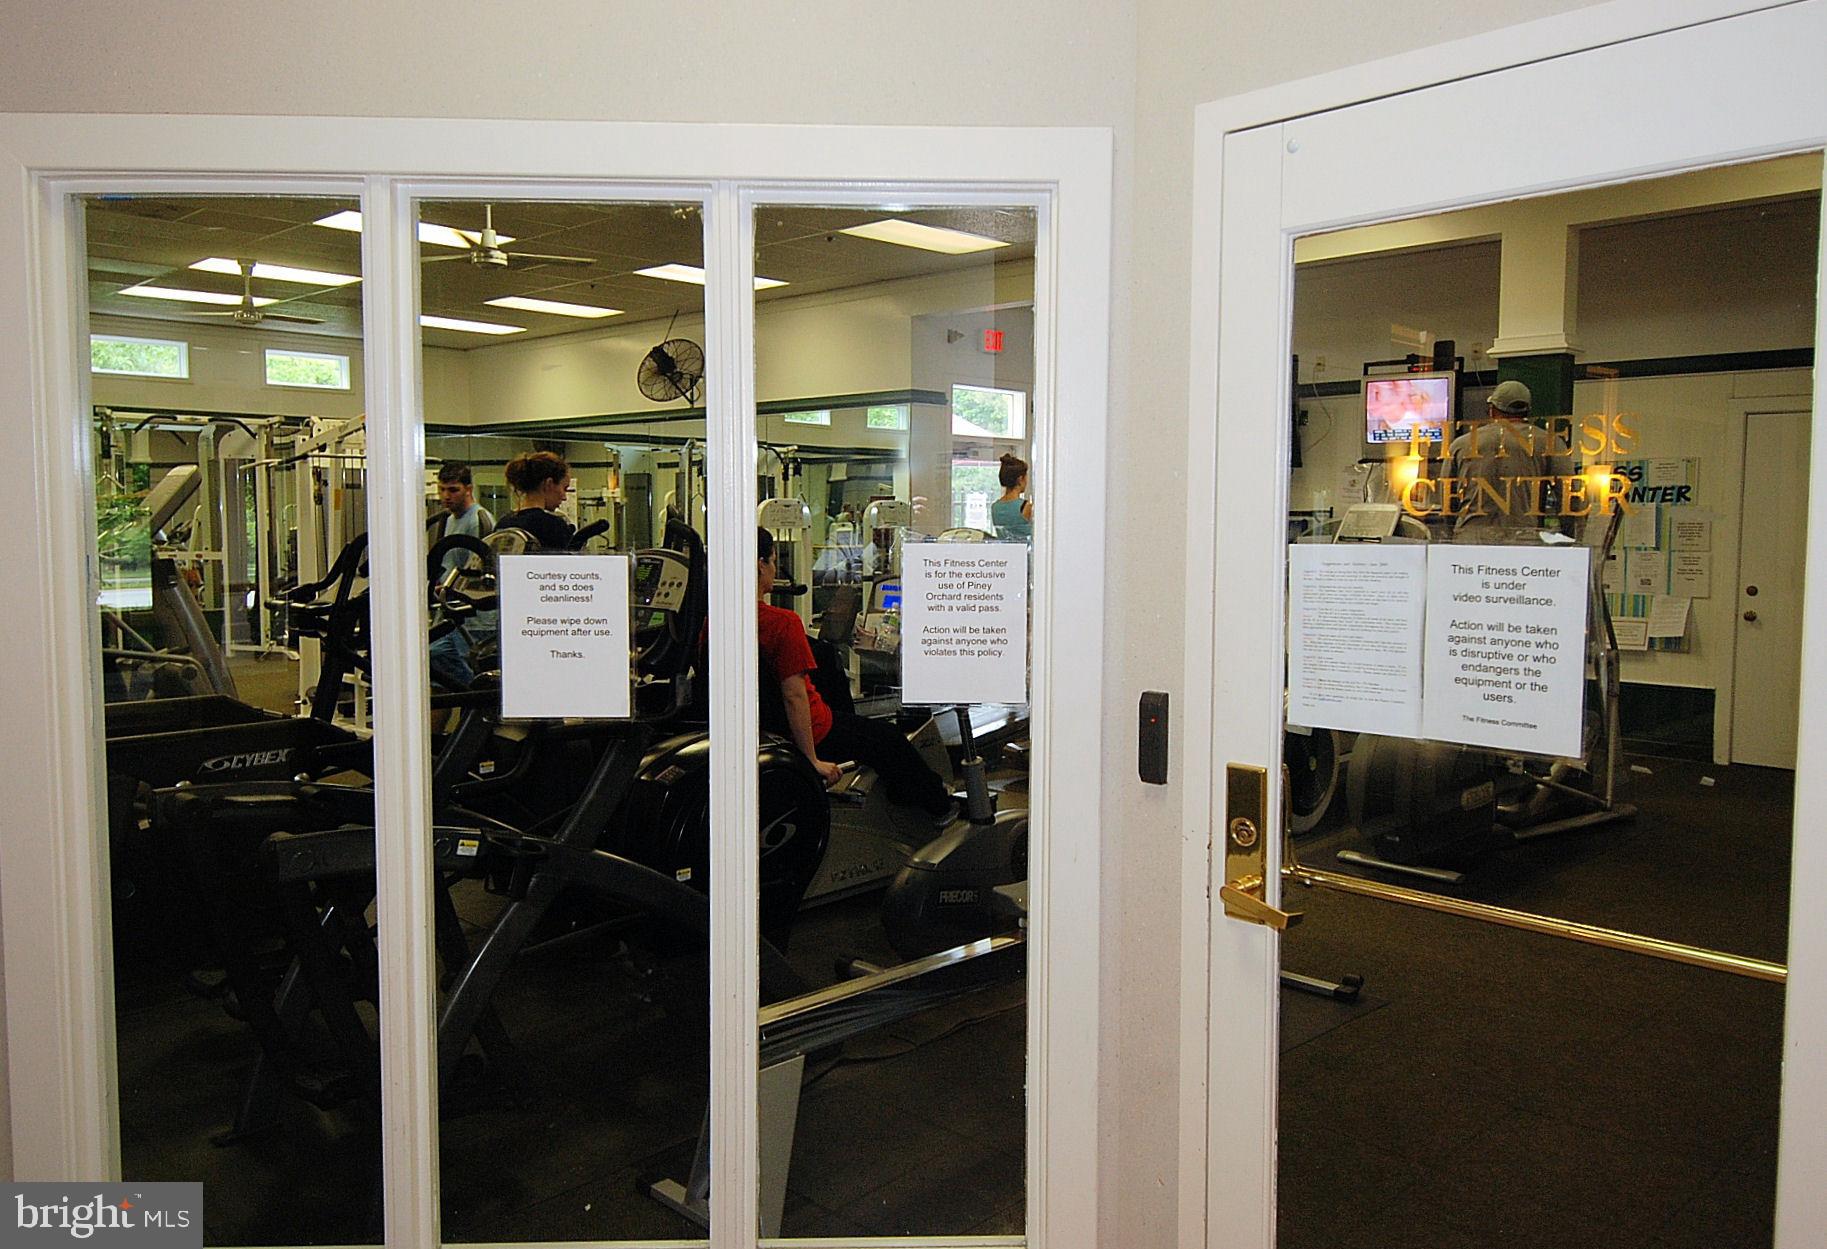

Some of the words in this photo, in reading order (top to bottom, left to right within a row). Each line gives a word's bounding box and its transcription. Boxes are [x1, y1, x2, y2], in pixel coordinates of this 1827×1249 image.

[1408, 412, 1641, 461] FITNESS
[1402, 474, 1640, 517] CENTER
[923, 559, 941, 568] This
[944, 559, 976, 568] Fitness
[978, 559, 1008, 568] Center
[526, 571, 567, 582] Courtesy
[570, 572, 602, 581] counts,
[925, 570, 932, 578] is
[935, 570, 946, 578] for
[948, 570, 963, 578] the
[965, 570, 1006, 578] exclusive
[1451, 564, 1474, 575] This
[1477, 565, 1518, 577] Fitness
[1521, 566, 1561, 578] Center
[967, 582, 992, 592] Piney
[1481, 579, 1490, 589] is
[1494, 580, 1526, 591] under
[540, 594, 593, 603] cleanliness!
[926, 592, 961, 601] Orchard
[964, 593, 1004, 601] residents
[1452, 593, 1482, 603] video
[1485, 594, 1556, 607] surveillance.
[927, 604, 945, 612] with
[956, 604, 976, 612] valid
[526, 617, 558, 625] Please
[560, 617, 581, 628] wipe
[583, 617, 608, 625] down
[1449, 620, 1483, 631] Action
[1486, 622, 1505, 632] will
[1507, 623, 1522, 634] be
[1525, 624, 1558, 636] taken
[521, 628, 569, 639] equipment
[570, 628, 591, 636] after
[922, 626, 950, 634] Action
[952, 626, 966, 634] will
[969, 626, 980, 634] be
[982, 626, 1006, 634] taken
[921, 637, 953, 647] against
[955, 638, 987, 647] anyone
[990, 637, 1008, 645] who
[1447, 634, 1487, 646] against
[1490, 637, 1532, 650] anyone
[1535, 639, 1559, 650] who
[550, 650, 585, 659] Thanks.
[924, 648, 957, 656] violates
[960, 648, 975, 656] this
[1448, 647, 1458, 657] is
[1460, 649, 1514, 662] disruptive
[1517, 653, 1530, 662] or
[1532, 653, 1557, 664] who
[1461, 662, 1520, 676] endangers
[1523, 666, 1542, 678] the
[1454, 675, 1512, 690] equipment
[1515, 680, 1527, 690] or
[1530, 682, 1548, 693] the
[1482, 691, 1517, 704] users.
[1462, 714, 1475, 723] The
[1476, 716, 1499, 726] Fitness
[1501, 719, 1538, 730] Committee
[229, 748, 294, 770] CYBEX
